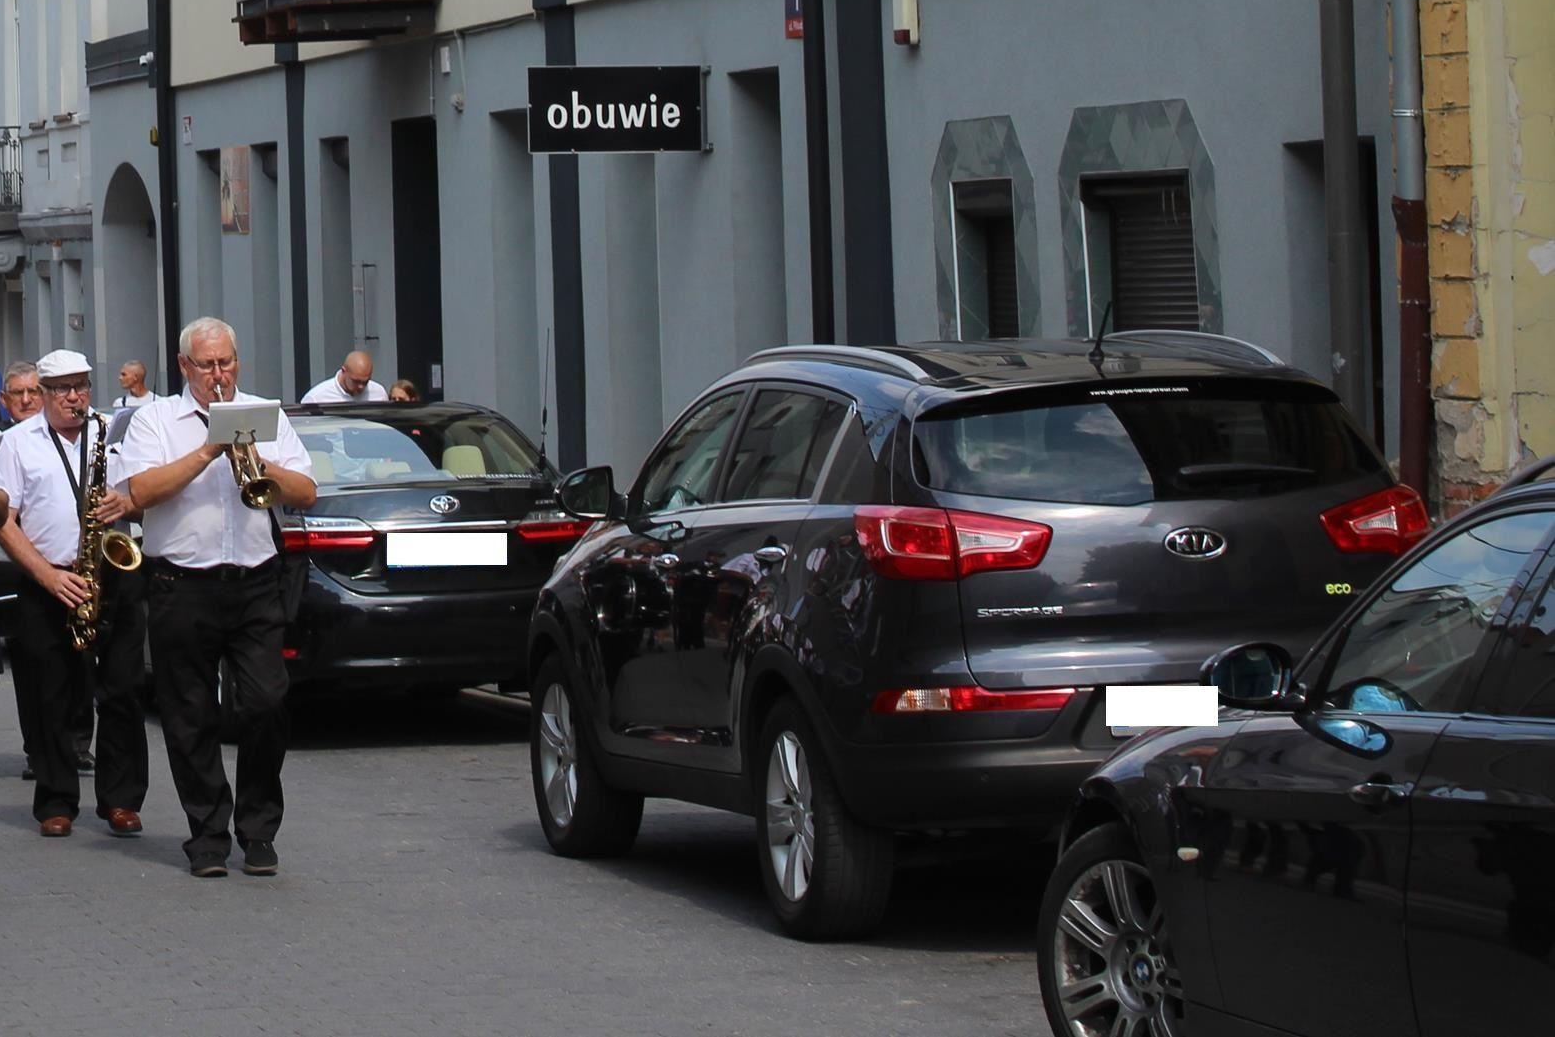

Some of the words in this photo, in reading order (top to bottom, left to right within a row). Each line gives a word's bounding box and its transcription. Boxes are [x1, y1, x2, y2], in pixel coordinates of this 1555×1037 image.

[547, 91, 681, 129] obuwie
[1175, 534, 1214, 551] KIA
[1326, 583, 1351, 594] eco
[977, 606, 1063, 617] SPORTAGE
